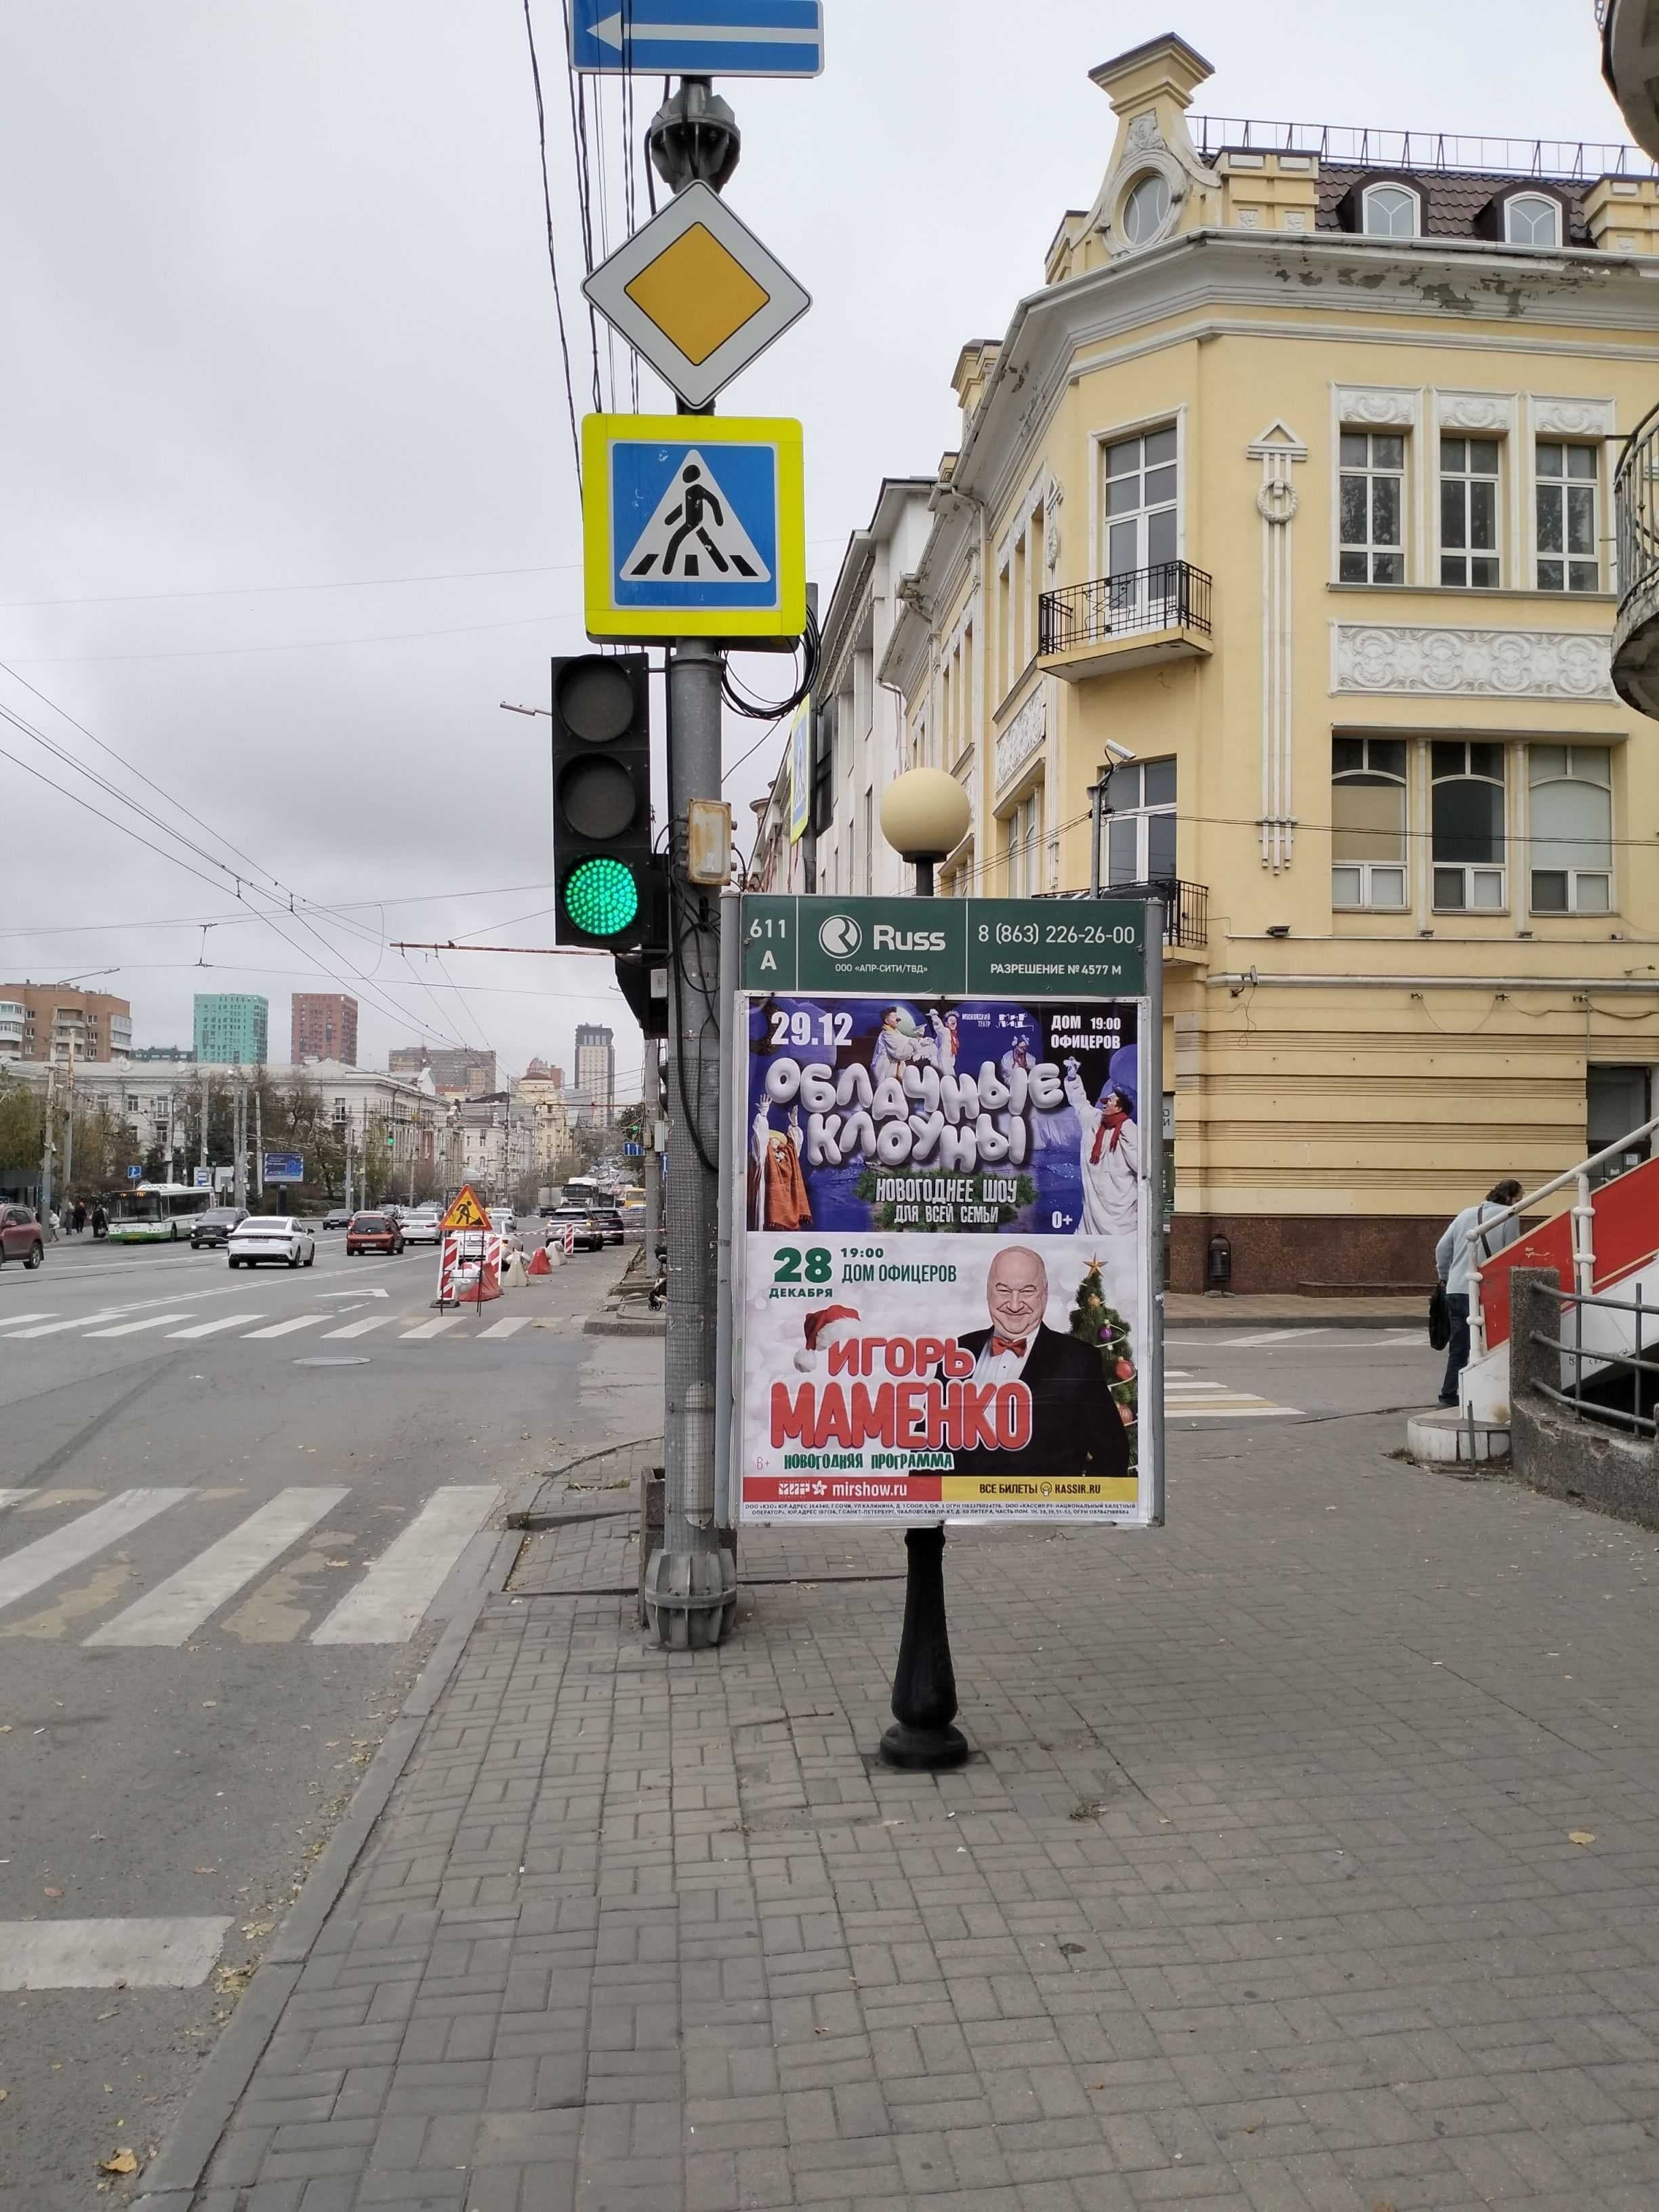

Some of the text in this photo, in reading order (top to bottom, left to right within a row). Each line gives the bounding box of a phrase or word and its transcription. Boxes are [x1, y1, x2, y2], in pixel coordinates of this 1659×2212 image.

[750, 919, 785, 939] 611
[873, 924, 946, 951] Russ
[978, 922, 1135, 945] 8 (863) 226-26-00
[835, 964, 928, 974] ООО «АПР-СИТИ/ТВД»
[990, 963, 1065, 975] РАЗРЕШЕНИЕ
[1081, 964, 1108, 975] 4577
[770, 1011, 853, 1047] 29.12
[1050, 1015, 1082, 1031] ДОМ
[1090, 1017, 1121, 1030] 19:00
[1050, 1034, 1121, 1050] ОФИЦЕРОВ
[765, 1058, 1064, 1124] ОБЛАЧНЫЕ
[806, 1109, 1027, 1173] КЛОУНЫ
[875, 1178, 1017, 1204] НОВОГОДНЕЕ ШОУ
[893, 1203, 999, 1224] ДЛЯ ВСЕЙ СЕМЬИ
[1051, 1210, 1073, 1229] 0+
[840, 1248, 884, 1258] 19:00
[773, 1247, 833, 1283] 28
[841, 1264, 957, 1284] ДОМ ОФИЦЕРОВ
[769, 1288, 833, 1299] ДЕКАБРЯ
[827, 1336, 975, 1378] ИГОРЬ
[771, 1381, 1031, 1450] МАМЕНКО
[756, 1456, 771, 1470] 6+
[783, 1452, 954, 1471] НОВОГОДНЯЯ ПРОГРАММА
[832, 1482, 907, 1497] mirshow.ru
[979, 1483, 1038, 1494] ВСЕ БИЛЕТЫ
